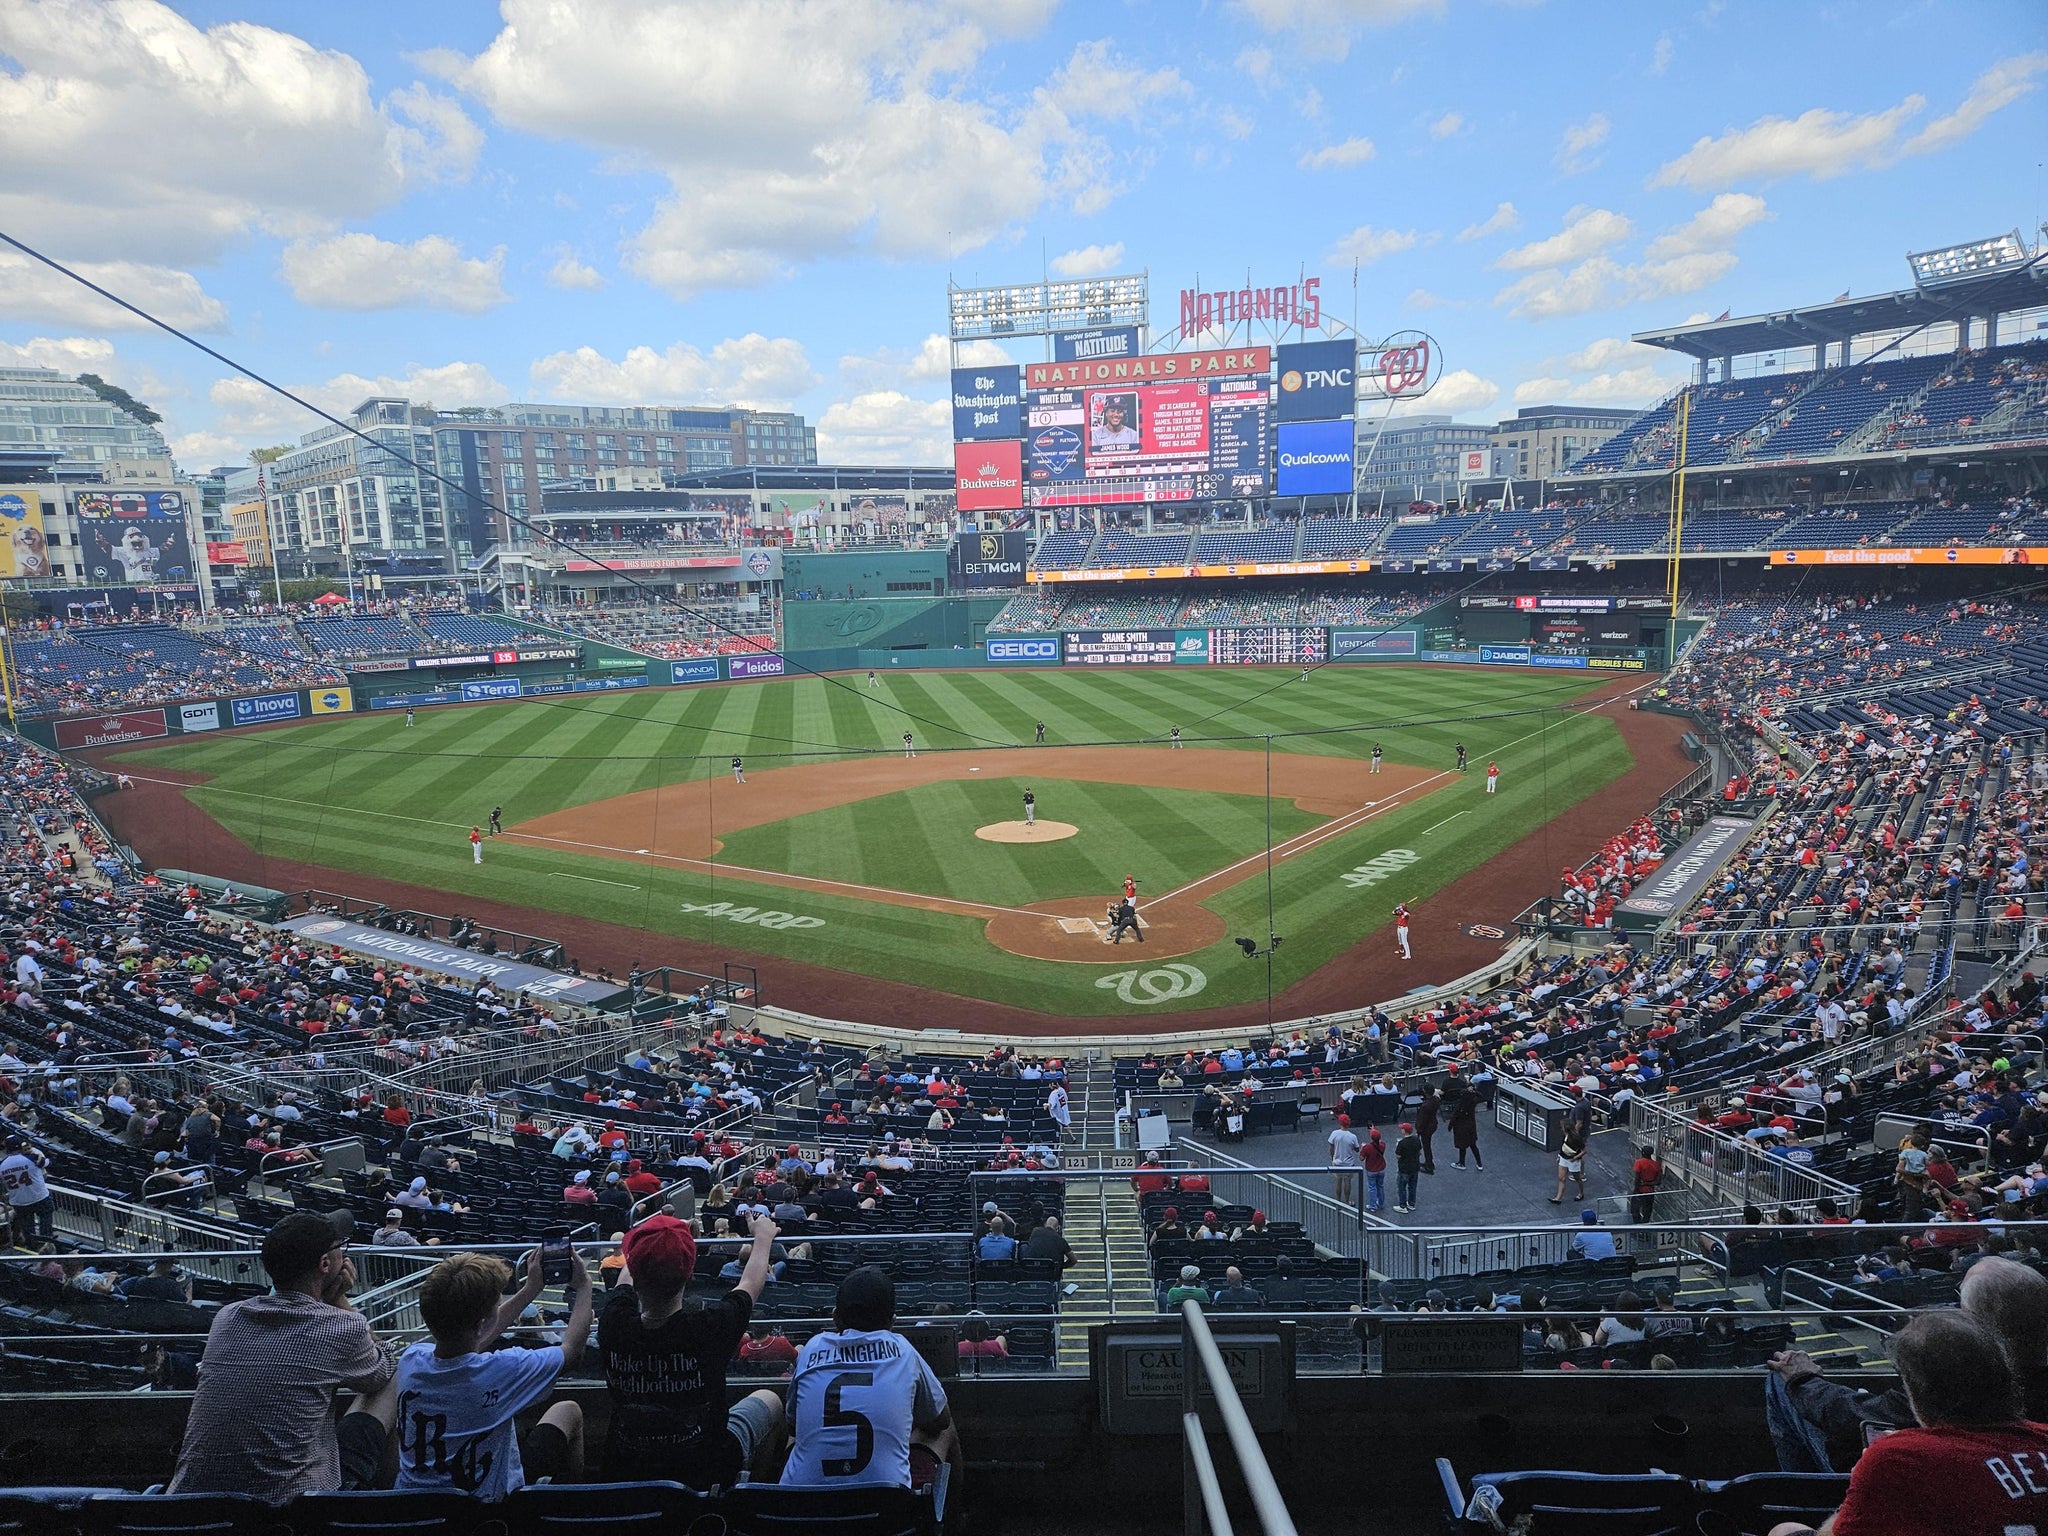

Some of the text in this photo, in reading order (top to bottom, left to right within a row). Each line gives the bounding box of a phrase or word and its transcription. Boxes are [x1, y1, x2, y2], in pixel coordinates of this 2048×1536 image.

[1180, 277, 1321, 339] NATIONALS
[1064, 330, 1103, 342] SHOW SOME
[1075, 335, 1128, 357] NATITUDE
[1034, 352, 1257, 383] NATIONALS PARK
[974, 376, 995, 390] The
[1304, 368, 1352, 390] PNC
[1220, 380, 1257, 392] NATIONALS
[954, 392, 1018, 410] Washington
[1039, 393, 1073, 404] WHITE SOX
[973, 411, 999, 428] Post
[1280, 452, 1350, 467] Qualcomm
[960, 478, 1017, 489] Budweiser
[1232, 478, 1263, 487] FANS
[1825, 550, 1853, 563] Feed
[1855, 549, 1876, 563] the
[623, 558, 692, 568] THIS BUD'S FOR YOU.
[964, 561, 1021, 575] BETMGM
[1062, 570, 1082, 580] Feed
[1083, 570, 1099, 579] the
[1256, 564, 1277, 575] Feed
[1278, 564, 1295, 574] the
[1540, 599, 1563, 607] WELCOME
[1102, 632, 1148, 643] SHANE SMITH
[1553, 631, 1566, 639] rely
[989, 642, 1056, 657] GEICO
[1338, 640, 1377, 648] VENTURE
[550, 649, 576, 659] FAN
[1492, 651, 1528, 660] DABOS
[353, 661, 406, 672] Harris Teeter
[415, 658, 440, 667] WELCOME
[448, 657, 475, 665] NATIONALS
[475, 655, 489, 663] PARK
[1535, 656, 1574, 665] citycruises
[1589, 659, 1644, 668] HERCULES FENCE
[684, 665, 716, 675] VANDA
[746, 660, 782, 674] leidos
[481, 683, 516, 696] Terra
[254, 698, 295, 713] Inova
[183, 707, 216, 719] GDIT
[84, 730, 142, 746] Budweiser
[1647, 826, 1737, 898] WASHINGTON NATIONALS
[1339, 848, 1423, 889] AARP
[680, 901, 826, 930] AARP
[346, 932, 513, 977] NATIONALS PARK
[514, 982, 560, 997] MLB
[1671, 1103, 1685, 1113] 123
[501, 1116, 515, 1126] 119
[534, 1121, 548, 1131] 120
[801, 1150, 817, 1160] 121
[1067, 1158, 1086, 1168] 121
[1114, 1158, 1133, 1168] 122
[4, 1170, 33, 1190] 24
[1659, 1231, 1678, 1246] 12
[1659, 1318, 1690, 1331] RENDON
[1389, 1327, 1433, 1338] PLEASE
[806, 1338, 901, 1366] BELLINGHAM
[609, 1351, 698, 1378] Wake Up The
[1139, 1351, 1247, 1368] CAUON
[1141, 1371, 1170, 1380] Please
[821, 1371, 875, 1477] 5
